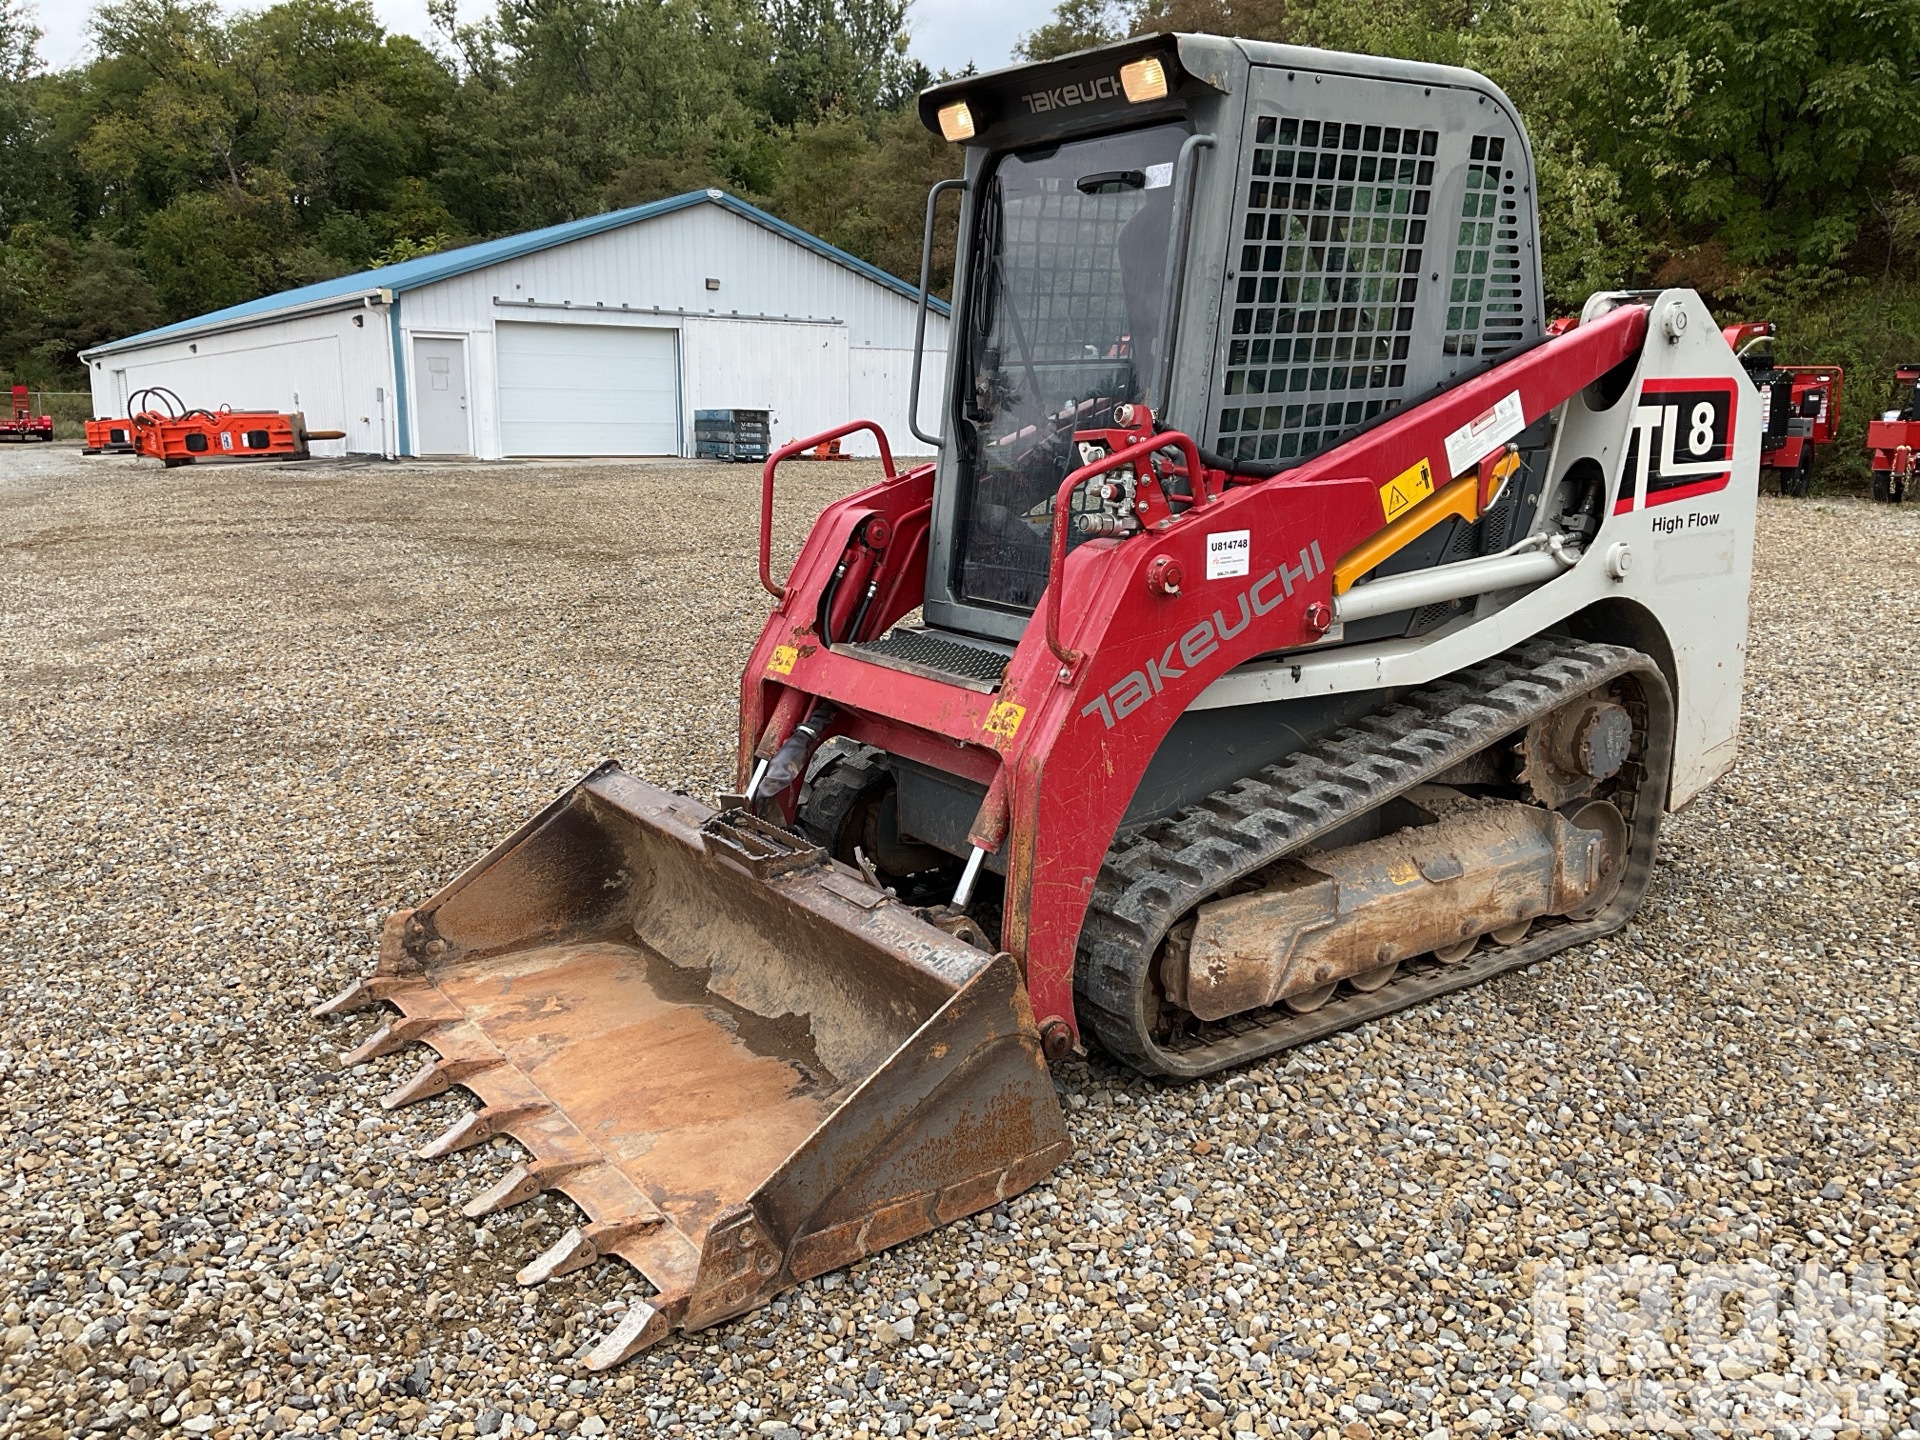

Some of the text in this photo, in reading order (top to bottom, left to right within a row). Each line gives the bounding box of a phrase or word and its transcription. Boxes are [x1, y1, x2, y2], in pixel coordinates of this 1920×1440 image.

[1021, 75, 1121, 114] TAKEUCH
[1632, 401, 1733, 512] TL8
[1651, 512, 1720, 534] High Flow
[1211, 539, 1248, 551] U814748
[1081, 540, 1326, 730] TAKEUCHI
